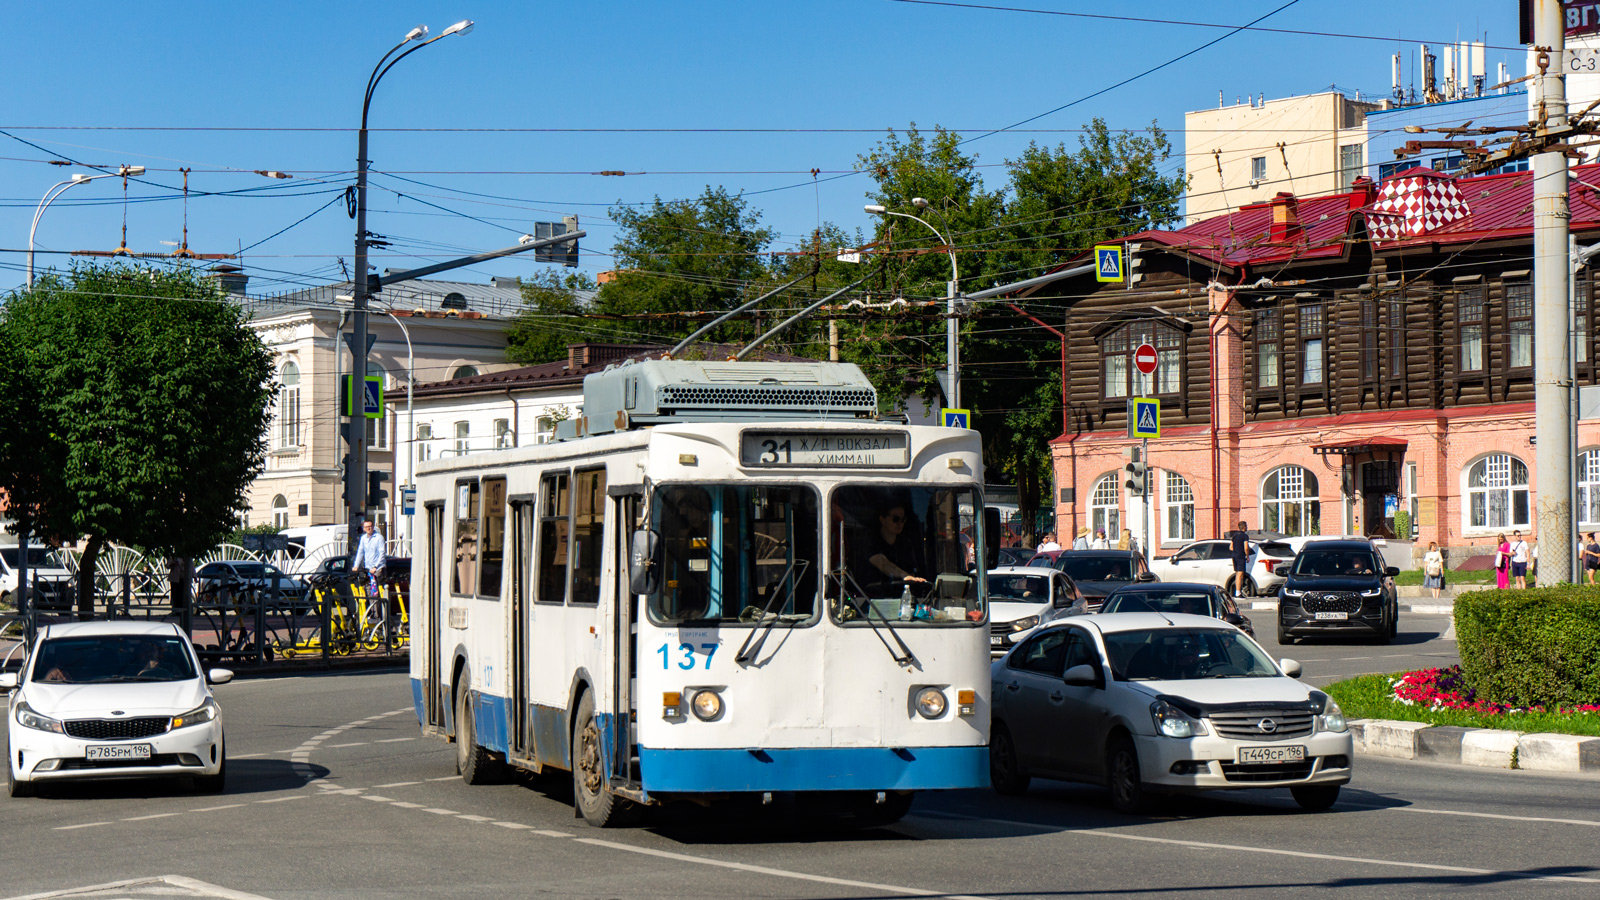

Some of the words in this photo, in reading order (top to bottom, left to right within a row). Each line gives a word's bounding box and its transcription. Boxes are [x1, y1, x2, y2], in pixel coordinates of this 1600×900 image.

[761, 439, 792, 464] 31
[799, 437, 830, 450] Ж/Д
[836, 437, 891, 450] ВОКЗАЛ
[817, 454, 875, 465] ХИММАШ
[657, 642, 719, 671] 137
[484, 665, 493, 688] 137
[90, 747, 131, 758] Р785РМ
[133, 746, 148, 754] 196
[1243, 748, 1284, 761] Т449СР
[1286, 746, 1302, 756] 196
